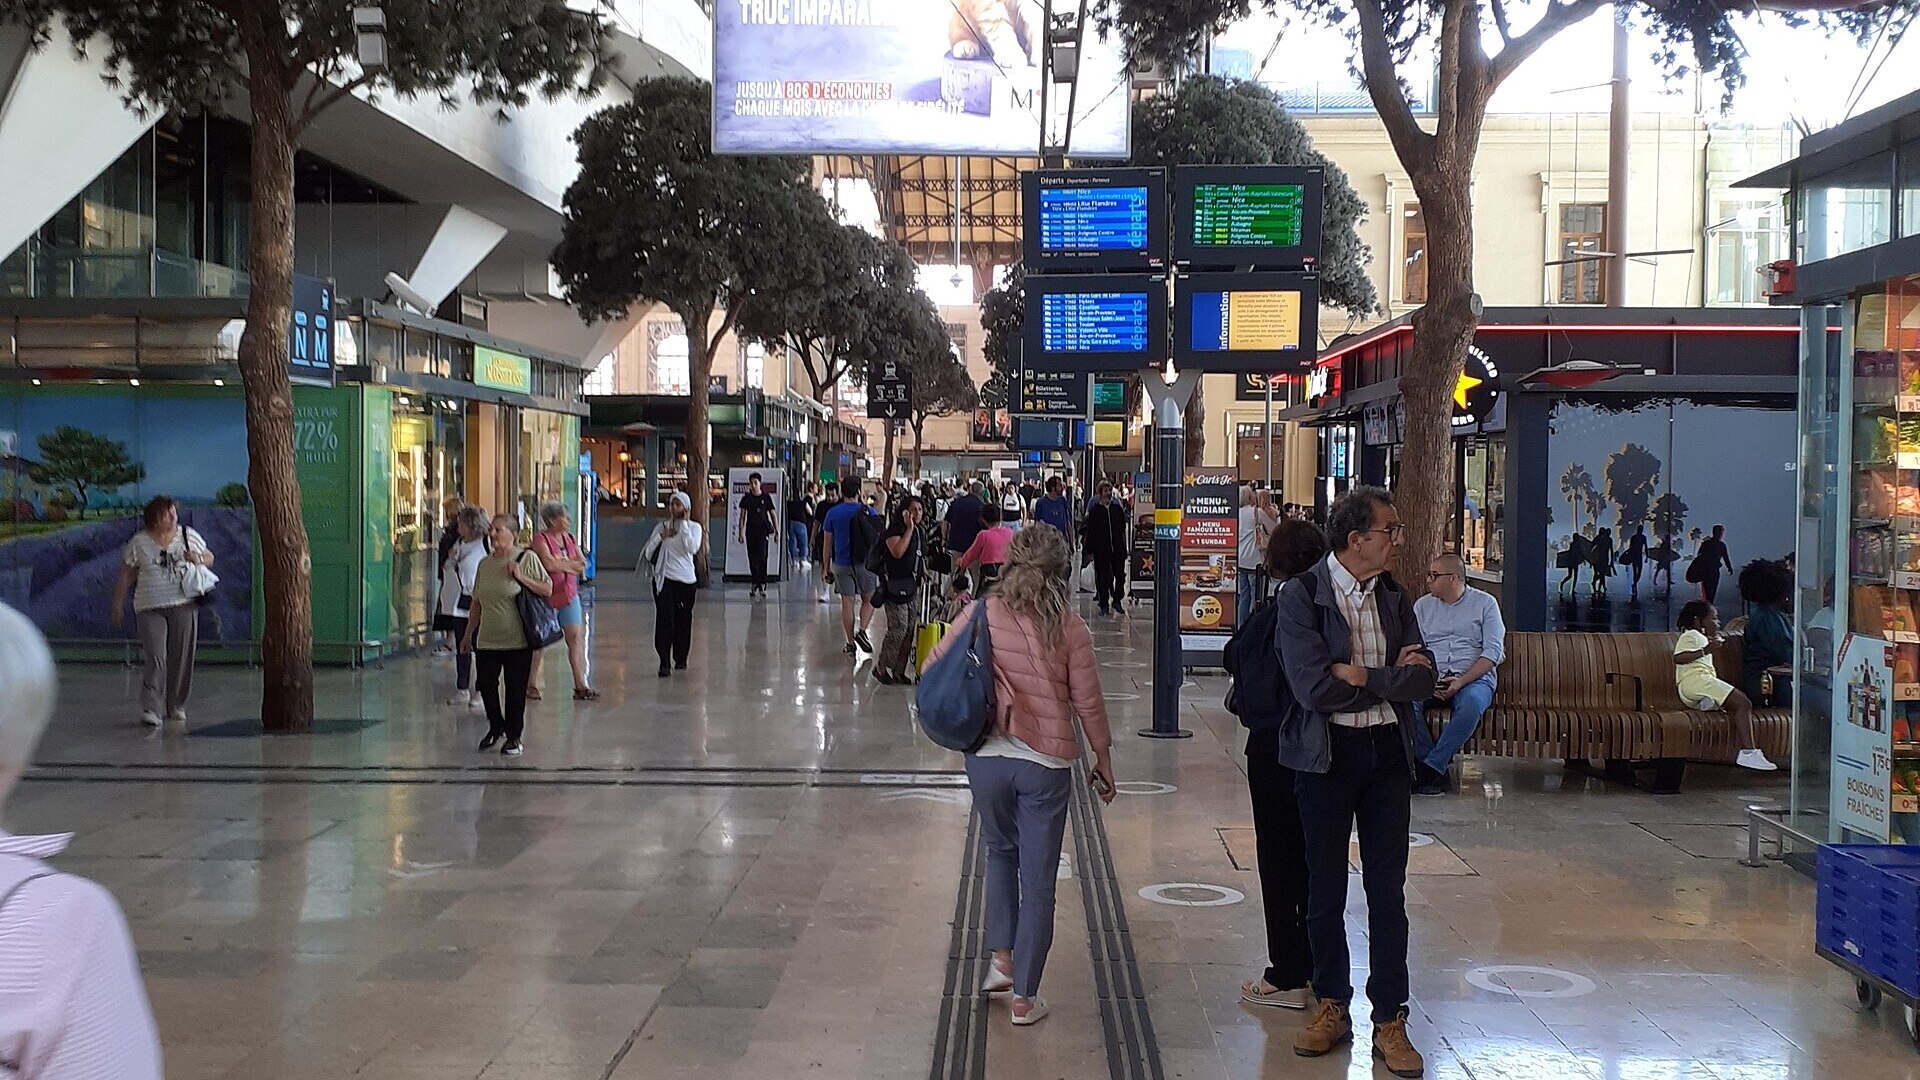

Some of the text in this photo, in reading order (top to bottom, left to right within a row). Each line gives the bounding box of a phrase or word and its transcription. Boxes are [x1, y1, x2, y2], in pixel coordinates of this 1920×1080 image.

[735, 100, 780, 117] CHAQUE
[783, 101, 812, 116] MOIS
[1131, 299, 1145, 350] départs
[1219, 291, 1229, 350] information
[314, 329, 328, 363] M
[294, 420, 338, 450] 72%
[1196, 473, 1219, 485] Carl's
[1186, 505, 1230, 514] ÉTUDIANT
[1196, 497, 1221, 505] MENU
[1847, 777, 1885, 802] BOISSONS
